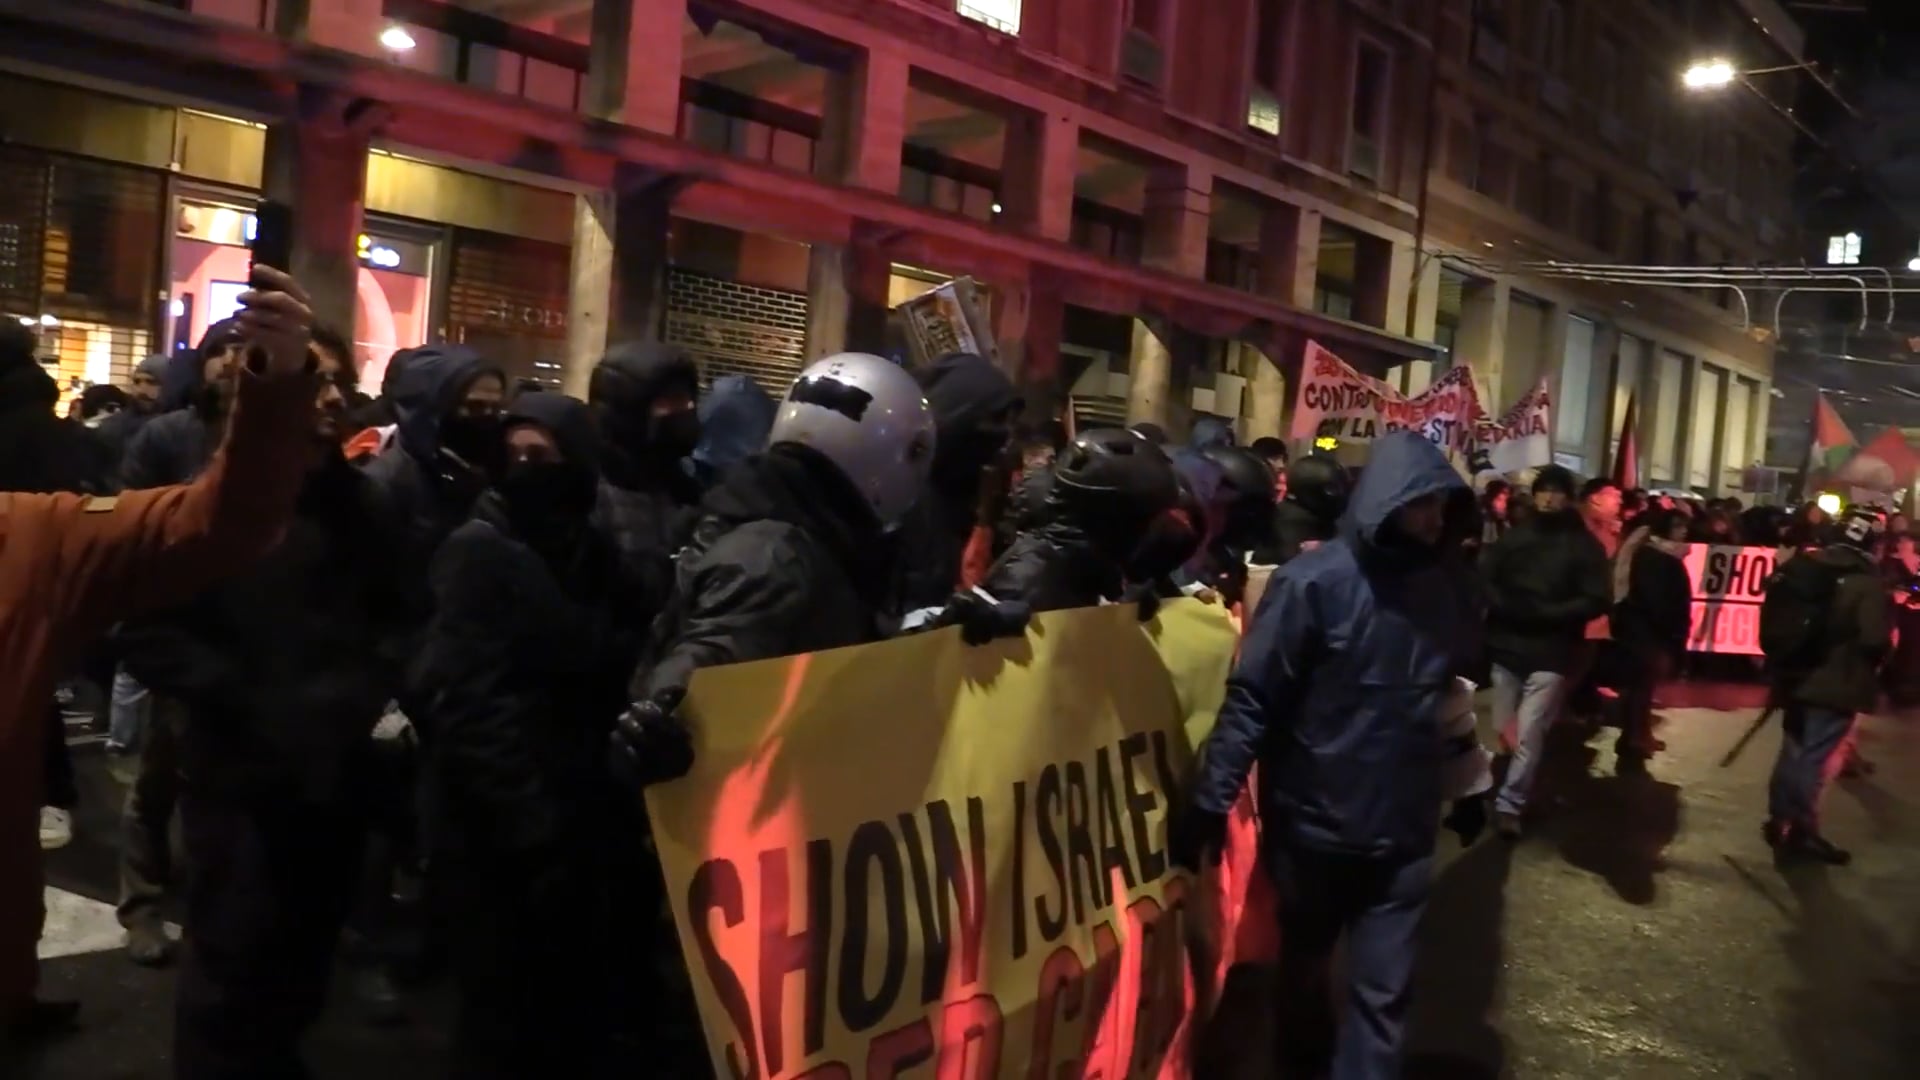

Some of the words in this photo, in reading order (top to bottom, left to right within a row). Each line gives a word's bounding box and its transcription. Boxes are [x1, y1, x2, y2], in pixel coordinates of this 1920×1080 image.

[1351, 417, 1376, 438] LA
[1706, 552, 1777, 597] SHO
[688, 797, 985, 1080] SHOW
